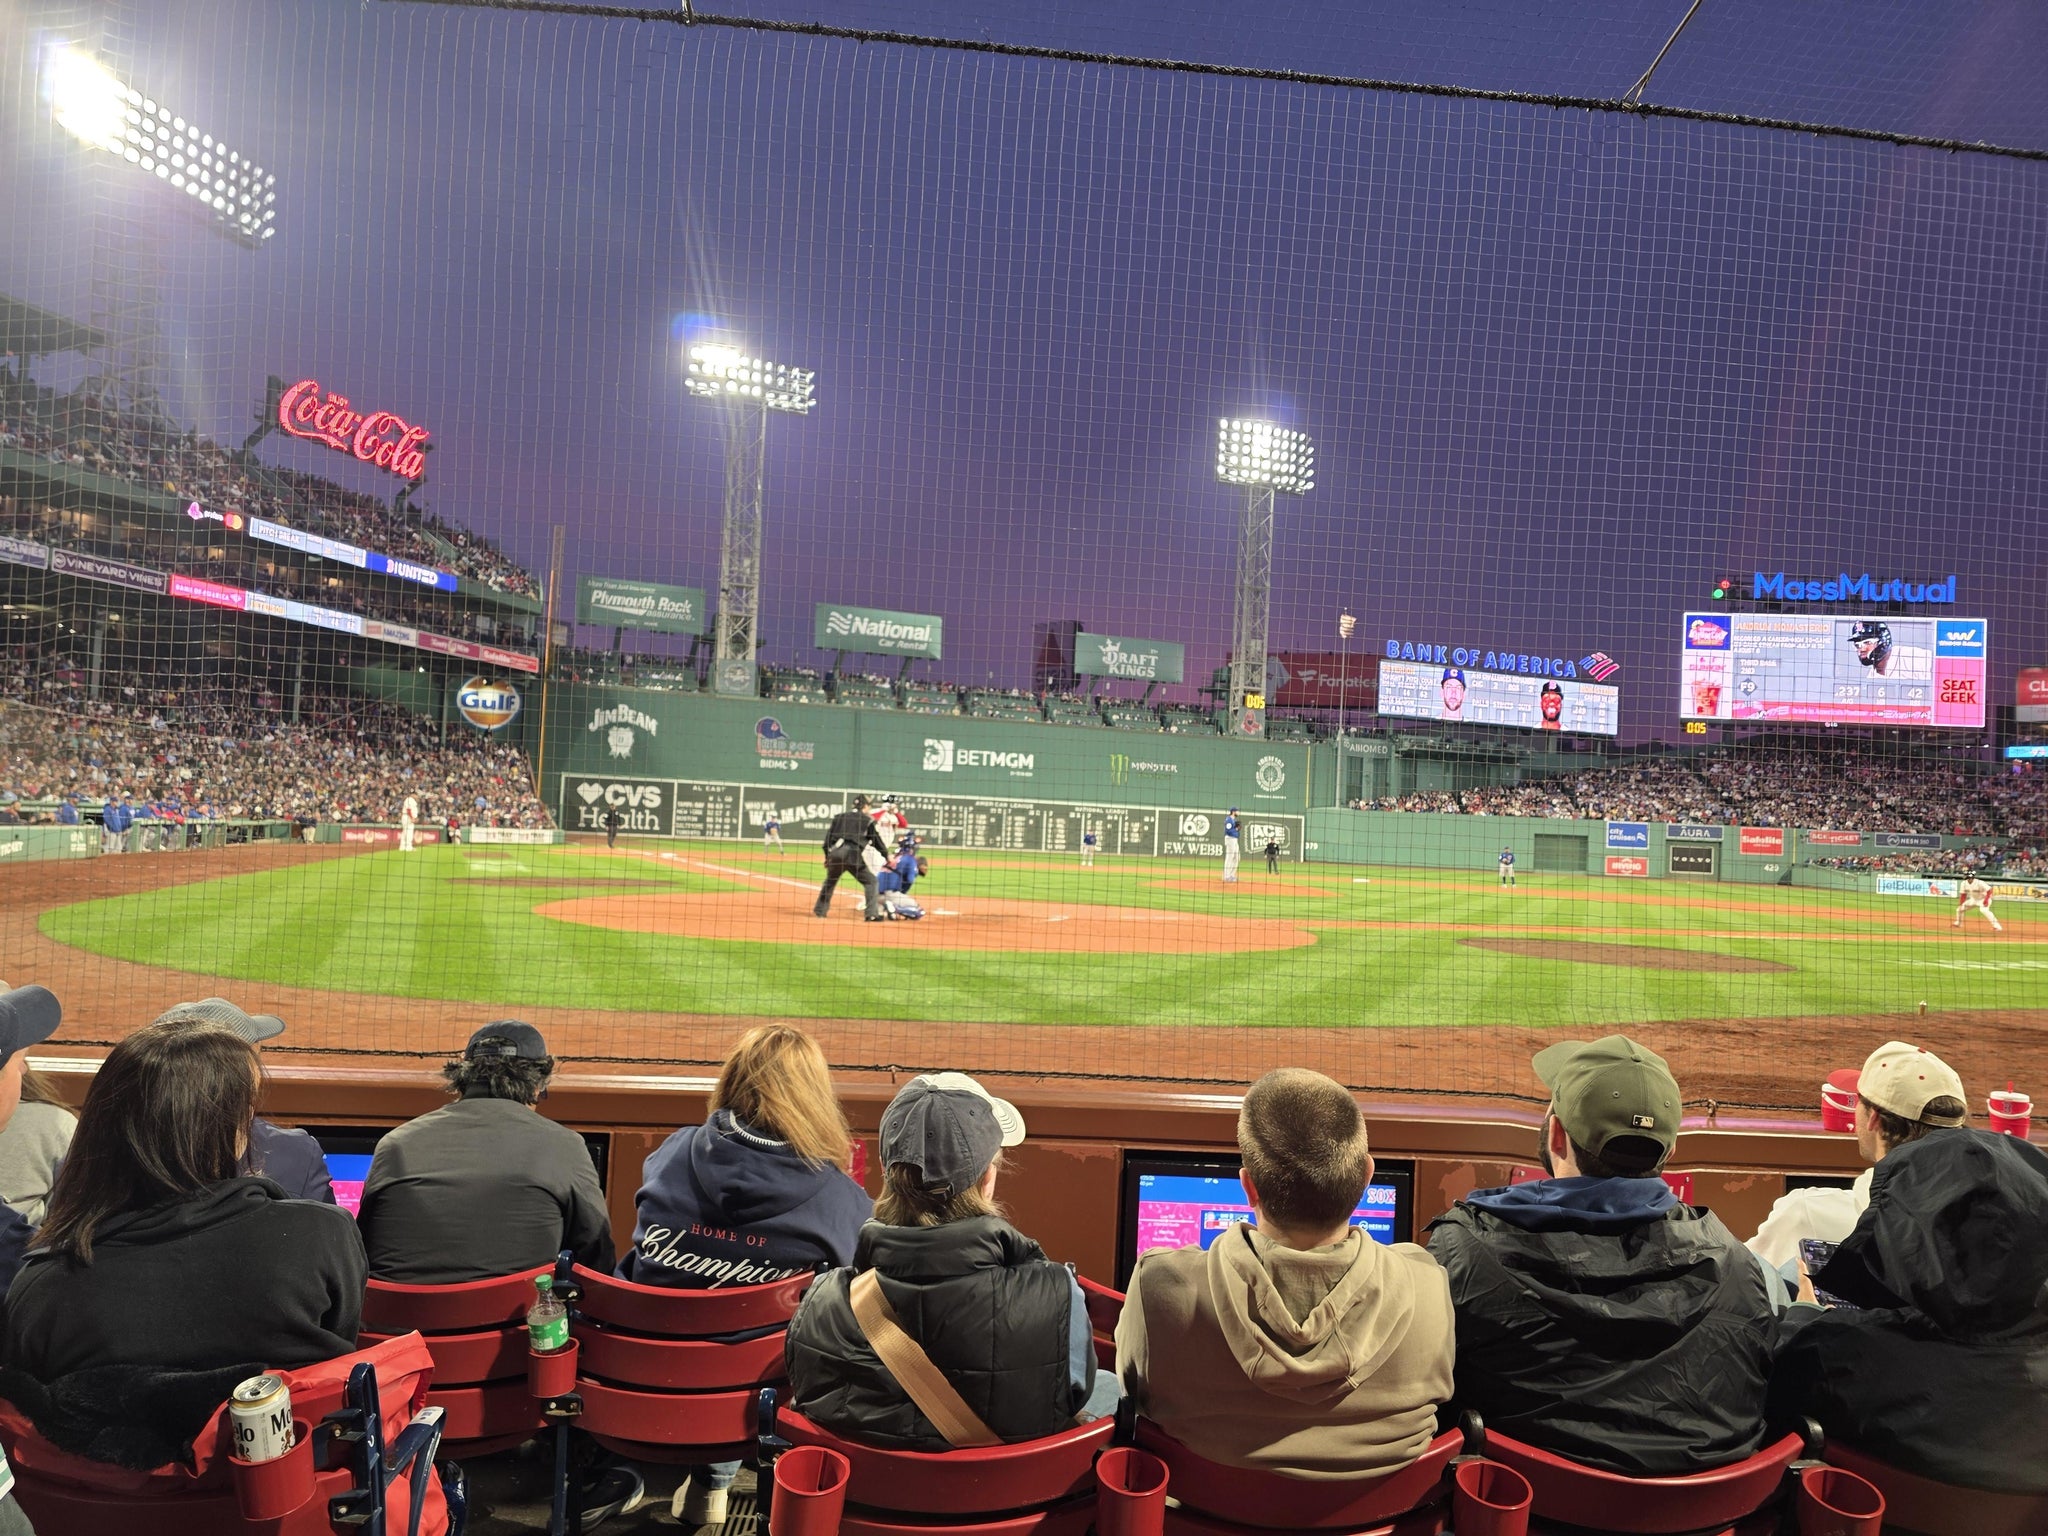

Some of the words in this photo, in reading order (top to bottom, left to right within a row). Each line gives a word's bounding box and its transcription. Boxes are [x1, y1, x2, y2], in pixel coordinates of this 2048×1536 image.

[327, 392, 348, 407] ENJOY
[279, 379, 430, 480] Coca-Cola
[67, 558, 127, 579] VINEYARD
[129, 571, 162, 587] VINES
[400, 562, 438, 585] UNITED
[1753, 572, 1956, 603] MassMutual
[591, 590, 655, 610] Plymouth
[657, 597, 692, 613] Rock
[851, 616, 930, 642] National
[878, 638, 895, 647] Car
[897, 641, 928, 650] Rental
[1102, 651, 1159, 666] DRAFT
[1387, 640, 1448, 664] BANK
[1452, 648, 1481, 667] OF
[1484, 651, 1577, 678] AMERICA
[1109, 662, 1156, 678] KINGS
[1319, 674, 1378, 689] Fanatics
[1740, 682, 1755, 692] F9
[1942, 679, 1976, 691] SEAT
[2029, 680, 2048, 692] CL
[1835, 686, 1860, 697] .237
[1877, 687, 1885, 697] 6
[1907, 688, 1922, 698] 42
[1940, 692, 1976, 704] GEEK
[461, 691, 515, 711] Gulf
[589, 708, 618, 732] JIM
[618, 704, 658, 737] BEAM
[1349, 743, 1388, 754] ABIOMED
[760, 759, 788, 769] BIDMC
[957, 749, 1034, 769] BETMGM
[1131, 762, 1178, 773] MONSTER
[605, 784, 661, 808] CVS
[781, 804, 843, 824] MASON
[1178, 814, 1210, 836] 160
[1253, 824, 1285, 838] ACE
[1609, 827, 1623, 837] city
[1900, 837, 1919, 845] NESN
[1164, 842, 1185, 854] F.W.
[1187, 843, 1223, 856] WEBB
[1881, 879, 1922, 893] jetBlue
[1367, 1188, 1396, 1204] SOX
[691, 1223, 737, 1242] HOME
[746, 1235, 769, 1248] OF
[641, 1224, 813, 1290] Champion
